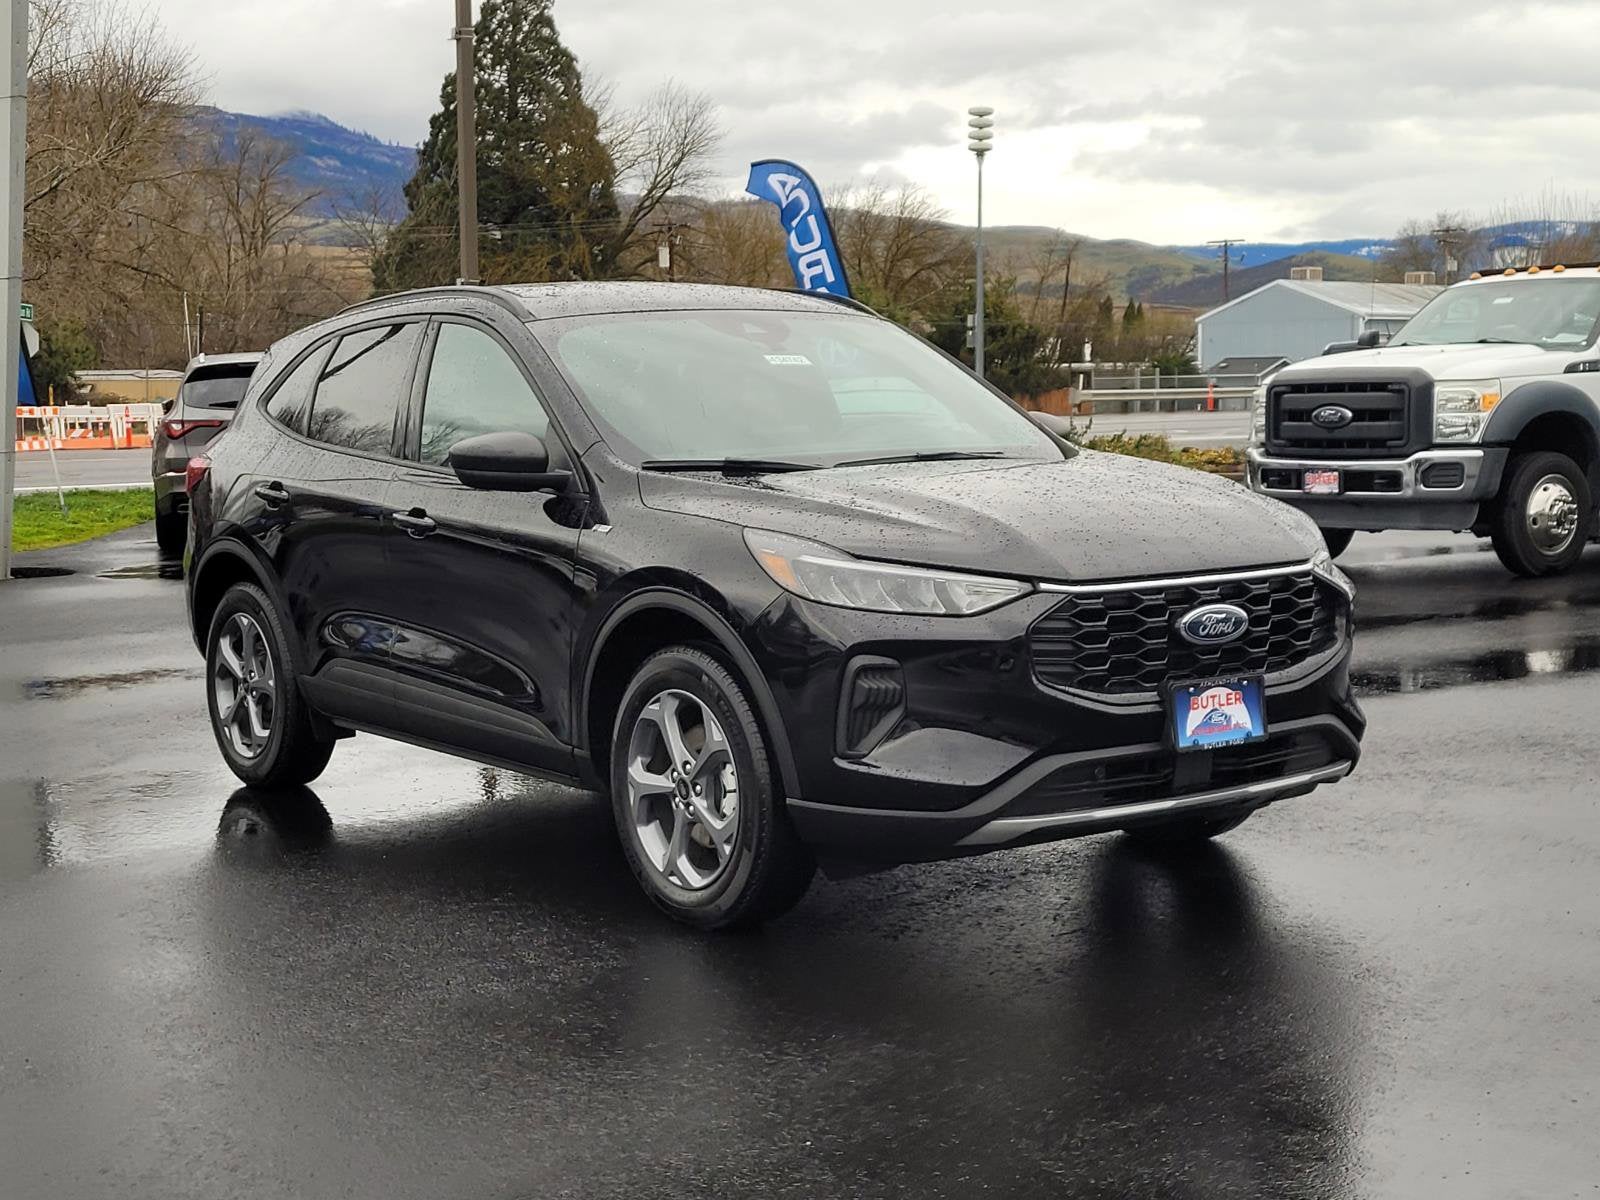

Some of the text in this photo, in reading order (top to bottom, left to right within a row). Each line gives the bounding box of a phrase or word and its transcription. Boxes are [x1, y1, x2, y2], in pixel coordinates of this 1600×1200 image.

[1199, 613, 1236, 636] Ford
[1190, 690, 1243, 711] BUTLER
[1203, 740, 1228, 750] BUTLER
